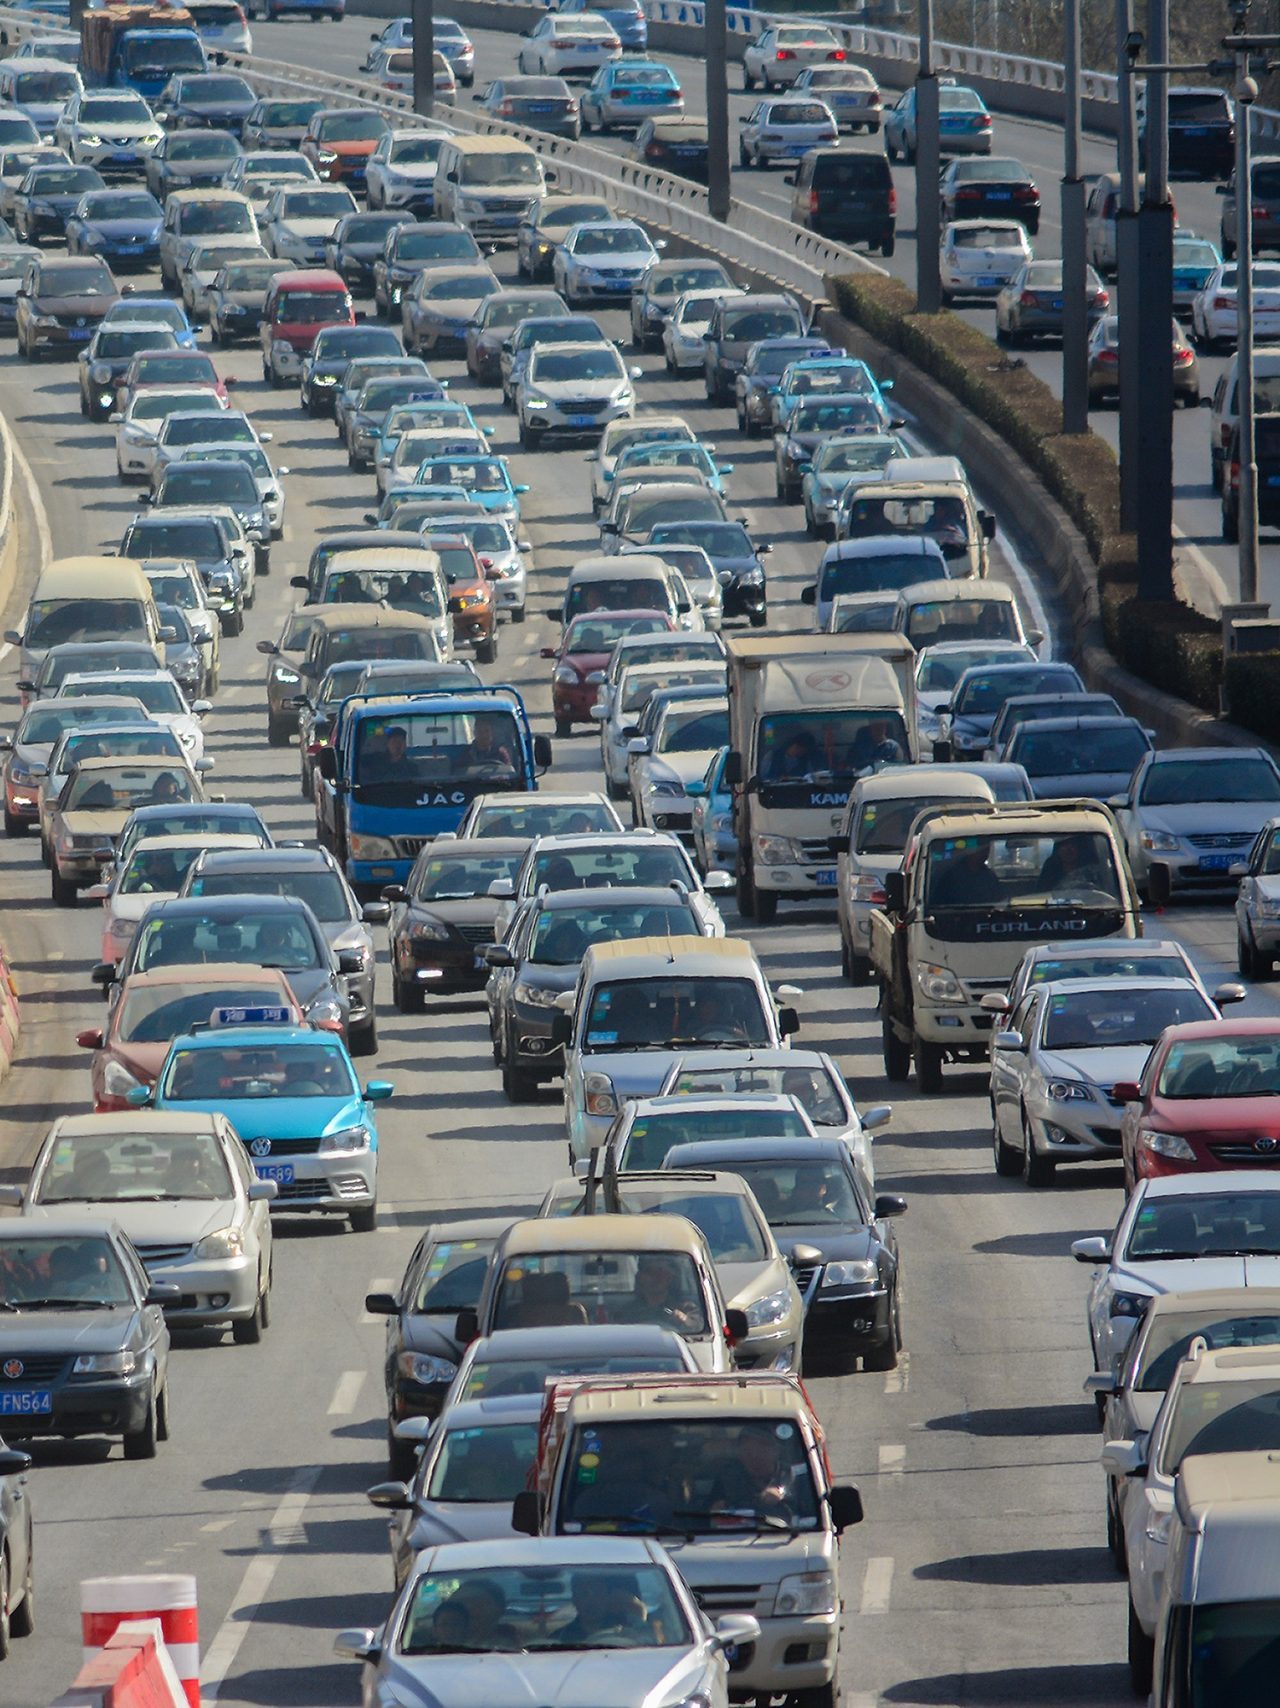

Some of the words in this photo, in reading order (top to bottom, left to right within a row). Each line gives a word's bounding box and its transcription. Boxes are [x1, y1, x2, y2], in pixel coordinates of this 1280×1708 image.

[416, 791, 465, 806] JAC
[976, 919, 1086, 933] FORLAND
[257, 1168, 293, 1183] 1589
